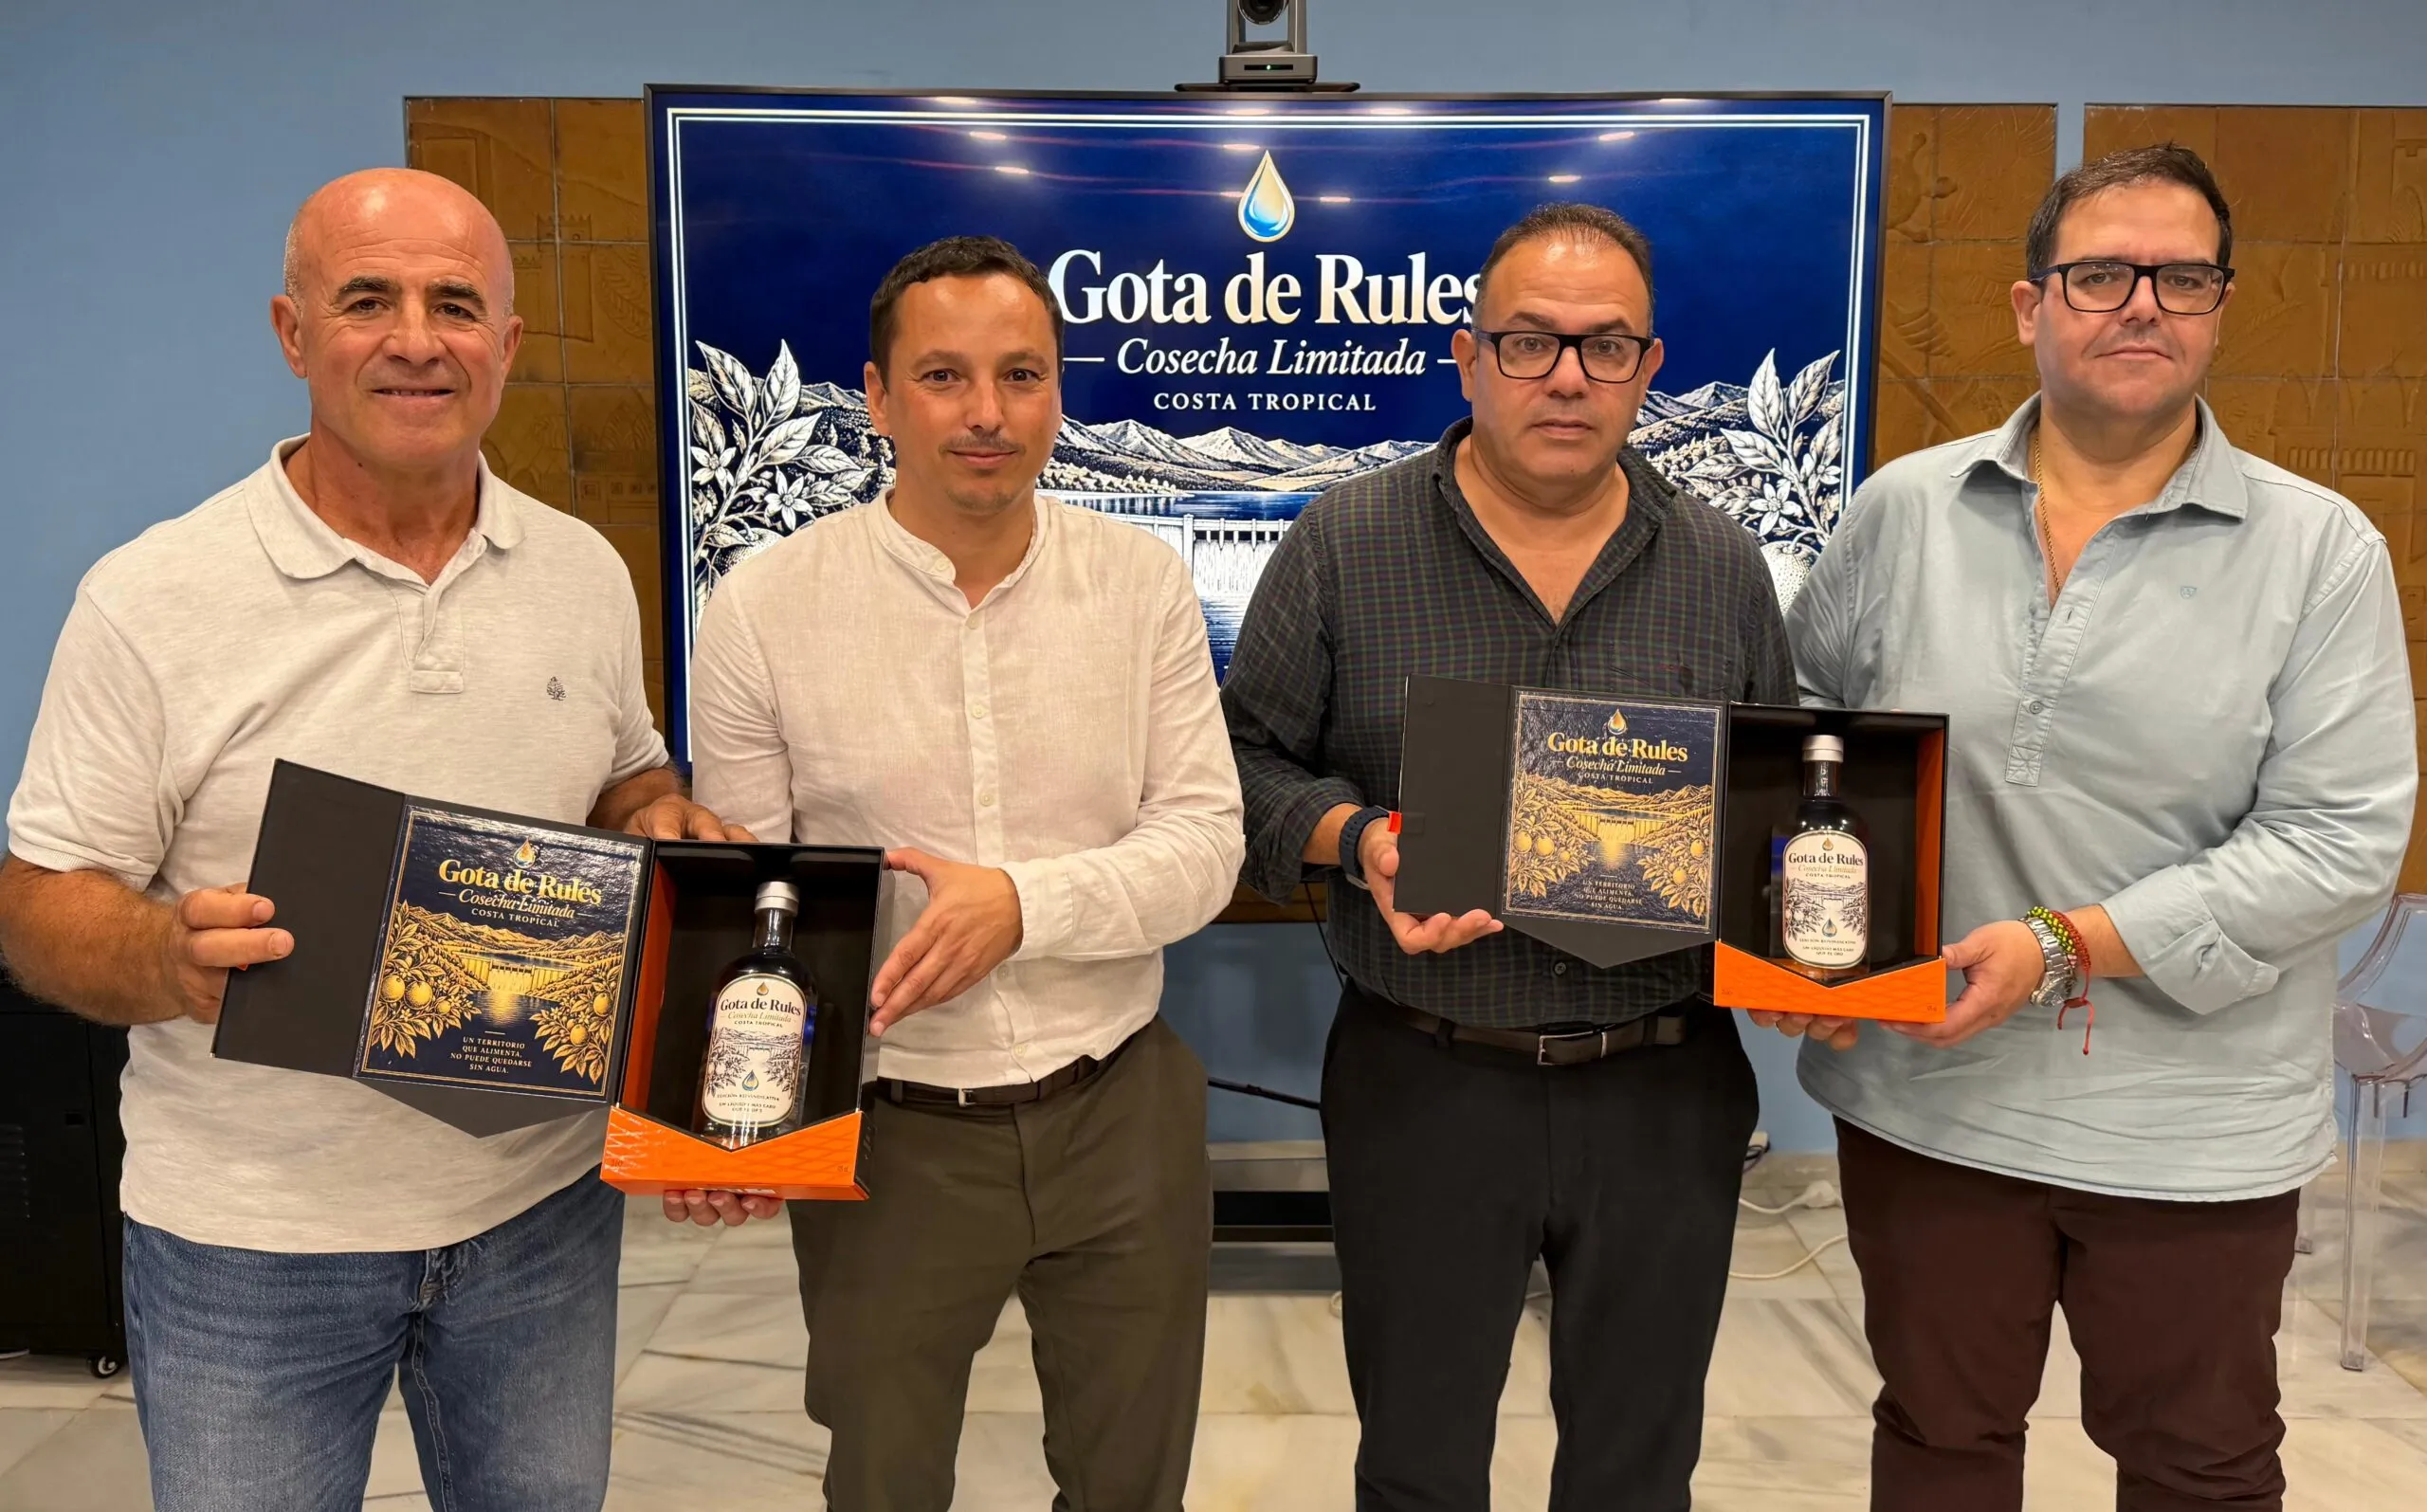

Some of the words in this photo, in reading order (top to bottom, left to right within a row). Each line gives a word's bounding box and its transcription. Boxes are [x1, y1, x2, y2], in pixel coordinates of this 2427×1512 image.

[1048, 249, 1212, 324] Gota
[1224, 251, 1302, 324] de
[1117, 337, 1258, 375] Cosecha
[1266, 337, 1426, 375] Limitada
[1153, 392, 1237, 410] COSTA
[1248, 392, 1377, 410] TROPICAL
[1547, 732, 1598, 756] Gota
[1601, 736, 1628, 757] de
[1632, 738, 1688, 762] Rules
[1566, 756, 1614, 772] Cosecha
[1615, 758, 1667, 775] Limitada
[1610, 774, 1653, 784] TROPICAL
[1788, 852, 1816, 864] Gota
[1818, 852, 1834, 865] de
[1836, 853, 1864, 866] Rules
[438, 859, 500, 889] Gota
[503, 868, 534, 894] de
[538, 874, 603, 904] Rules
[458, 888, 517, 909] Cosecha
[471, 907, 505, 920] COSTA
[509, 913, 560, 928] TROPICAL
[721, 998, 748, 1011] Gota
[750, 997, 768, 1011] de
[770, 998, 802, 1016] Rules
[477, 1038, 525, 1049] TERRITORIO
[465, 1054, 490, 1063] PUEDE
[492, 1057, 533, 1067] QUEDARSE
[469, 1063, 484, 1071] SIN
[485, 1066, 509, 1074] AGUA.
